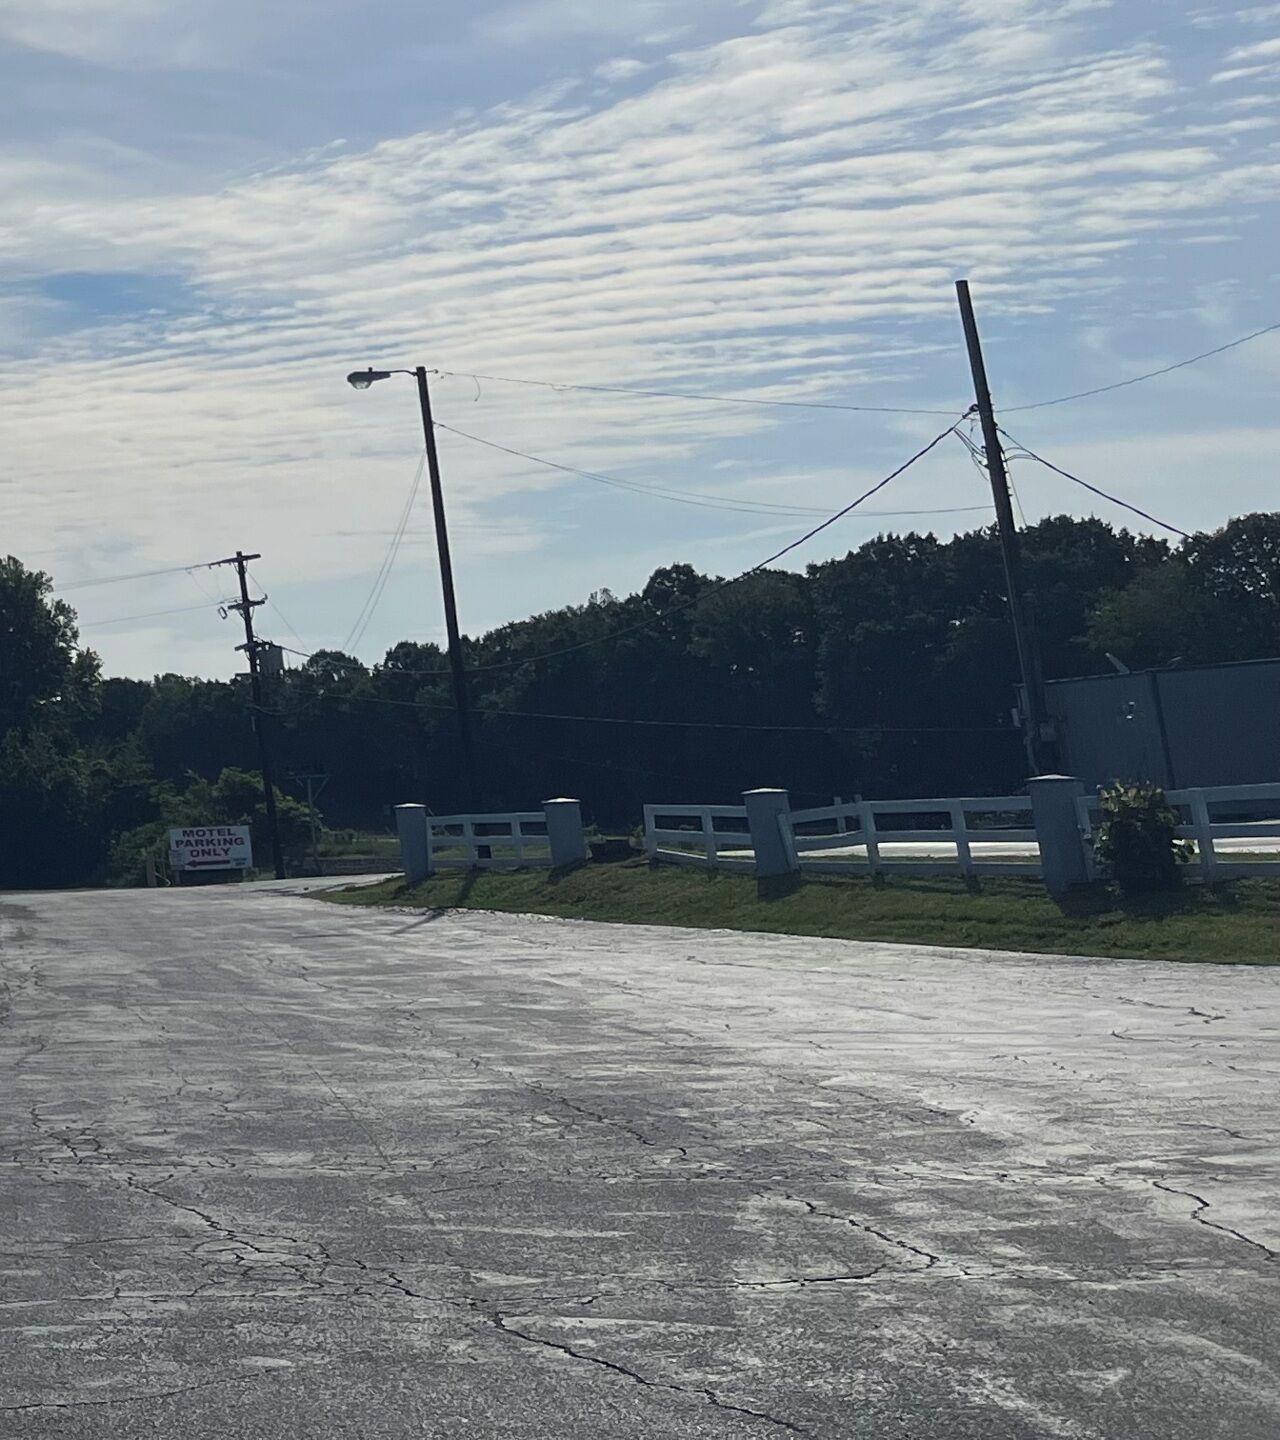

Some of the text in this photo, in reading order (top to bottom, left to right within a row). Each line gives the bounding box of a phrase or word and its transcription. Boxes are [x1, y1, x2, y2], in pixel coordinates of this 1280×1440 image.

[182, 828, 236, 838] MOTEL
[175, 837, 245, 848] PARKING
[190, 847, 231, 858] ONLY
